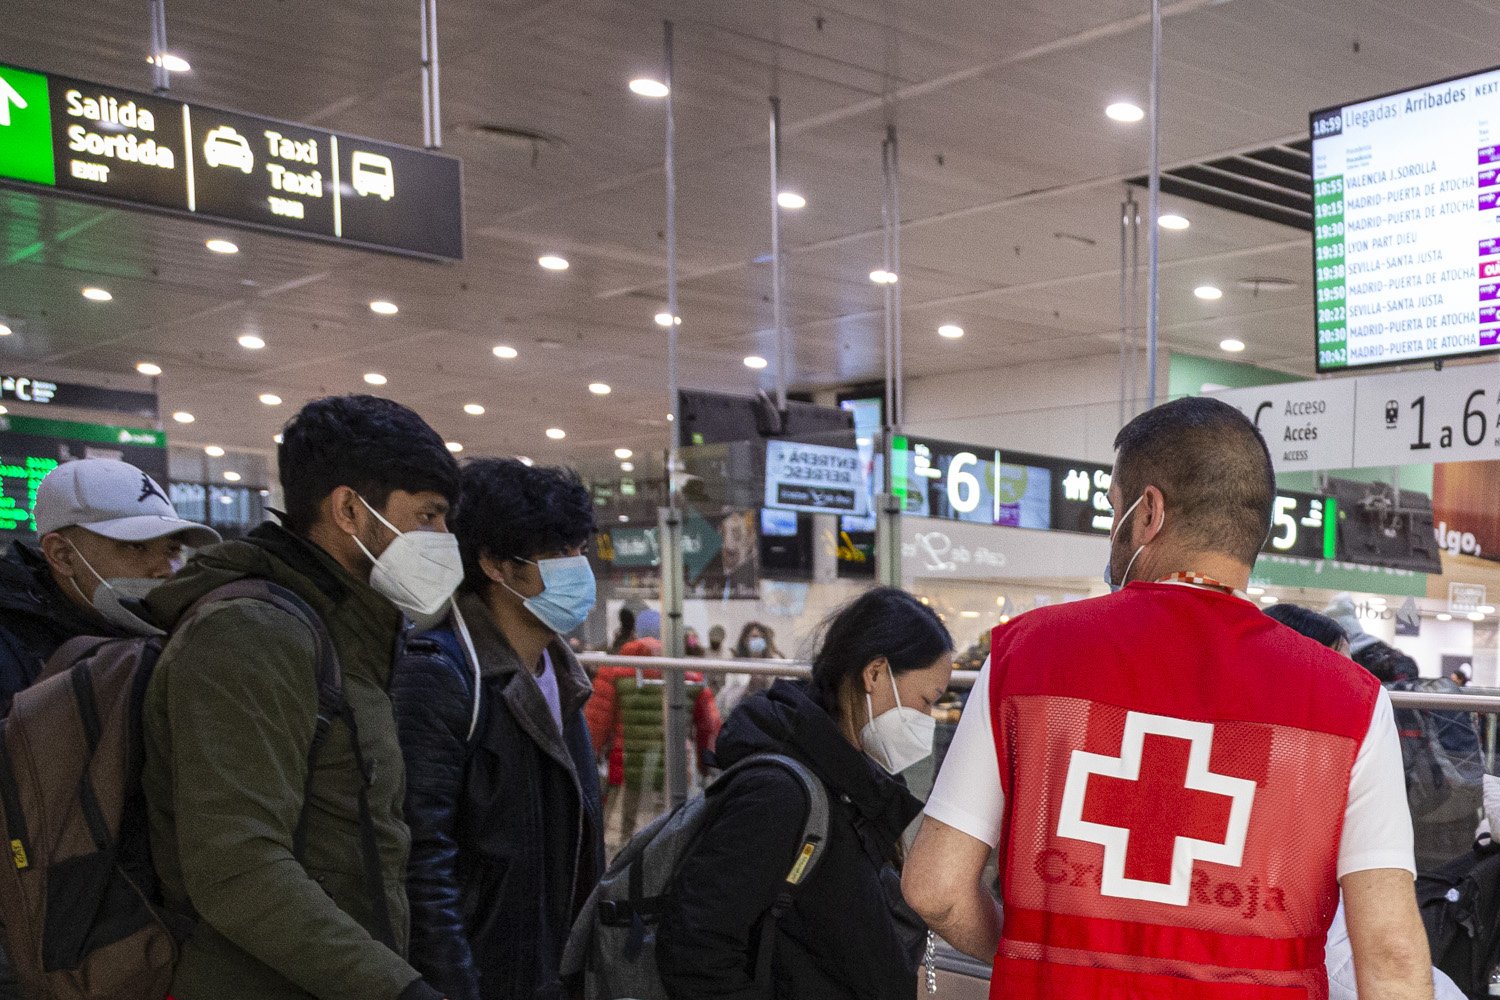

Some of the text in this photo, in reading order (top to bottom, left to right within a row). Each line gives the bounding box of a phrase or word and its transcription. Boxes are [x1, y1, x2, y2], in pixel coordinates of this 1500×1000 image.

[66, 89, 154, 131] Salida
[1313, 115, 1342, 136] 18:59
[1345, 103, 1397, 128] Llegadas
[1404, 88, 1466, 114] Arribades
[1475, 82, 1498, 97] NEXT
[67, 124, 174, 169] Sortida
[264, 130, 318, 164] Taxi
[266, 163, 322, 198] Taxi
[1315, 180, 1343, 197] 18:55
[1346, 170, 1387, 189] VALENCIA
[1389, 160, 1437, 182] J.SOROLLA
[1315, 201, 1343, 218] 19:15
[1347, 182, 1421, 210] MADRID-PUERTA
[1424, 181, 1435, 196] DE
[1439, 176, 1475, 193] ATOCHA
[1315, 222, 1344, 240] 19:30
[1347, 206, 1421, 232] MADRID-PUERTA
[1425, 205, 1435, 219] DE
[1439, 199, 1475, 215] ATOCHA
[1316, 243, 1344, 260] 19:33
[1349, 240, 1369, 254] LYON
[1372, 235, 1393, 249] PART
[1397, 232, 1417, 245] DIEU
[1348, 254, 1413, 275] SEVILLA-SANTA
[1417, 249, 1443, 264] JUSTA
[1349, 274, 1422, 297] MADRID-PUERTA
[1426, 272, 1436, 285] DE
[1440, 267, 1475, 282] ATOCHA
[1349, 296, 1414, 317] SEVILLA-SANTA
[1417, 293, 1443, 308] JUSTA
[1350, 319, 1423, 338] MADRID-PUERTA
[1426, 315, 1437, 328] DE
[1441, 311, 1476, 326] ATOCHA
[1350, 339, 1423, 358] MADRID-PUERTA
[1426, 336, 1437, 350] DE
[1441, 333, 1476, 348] ATOCHA
[1284, 399, 1326, 417] Acceso
[1409, 389, 1487, 450] 1 a 6
[1284, 422, 1318, 442] Accés
[1282, 449, 1309, 461] ACCESS
[947, 452, 981, 513] 6
[1273, 496, 1298, 550] 5
